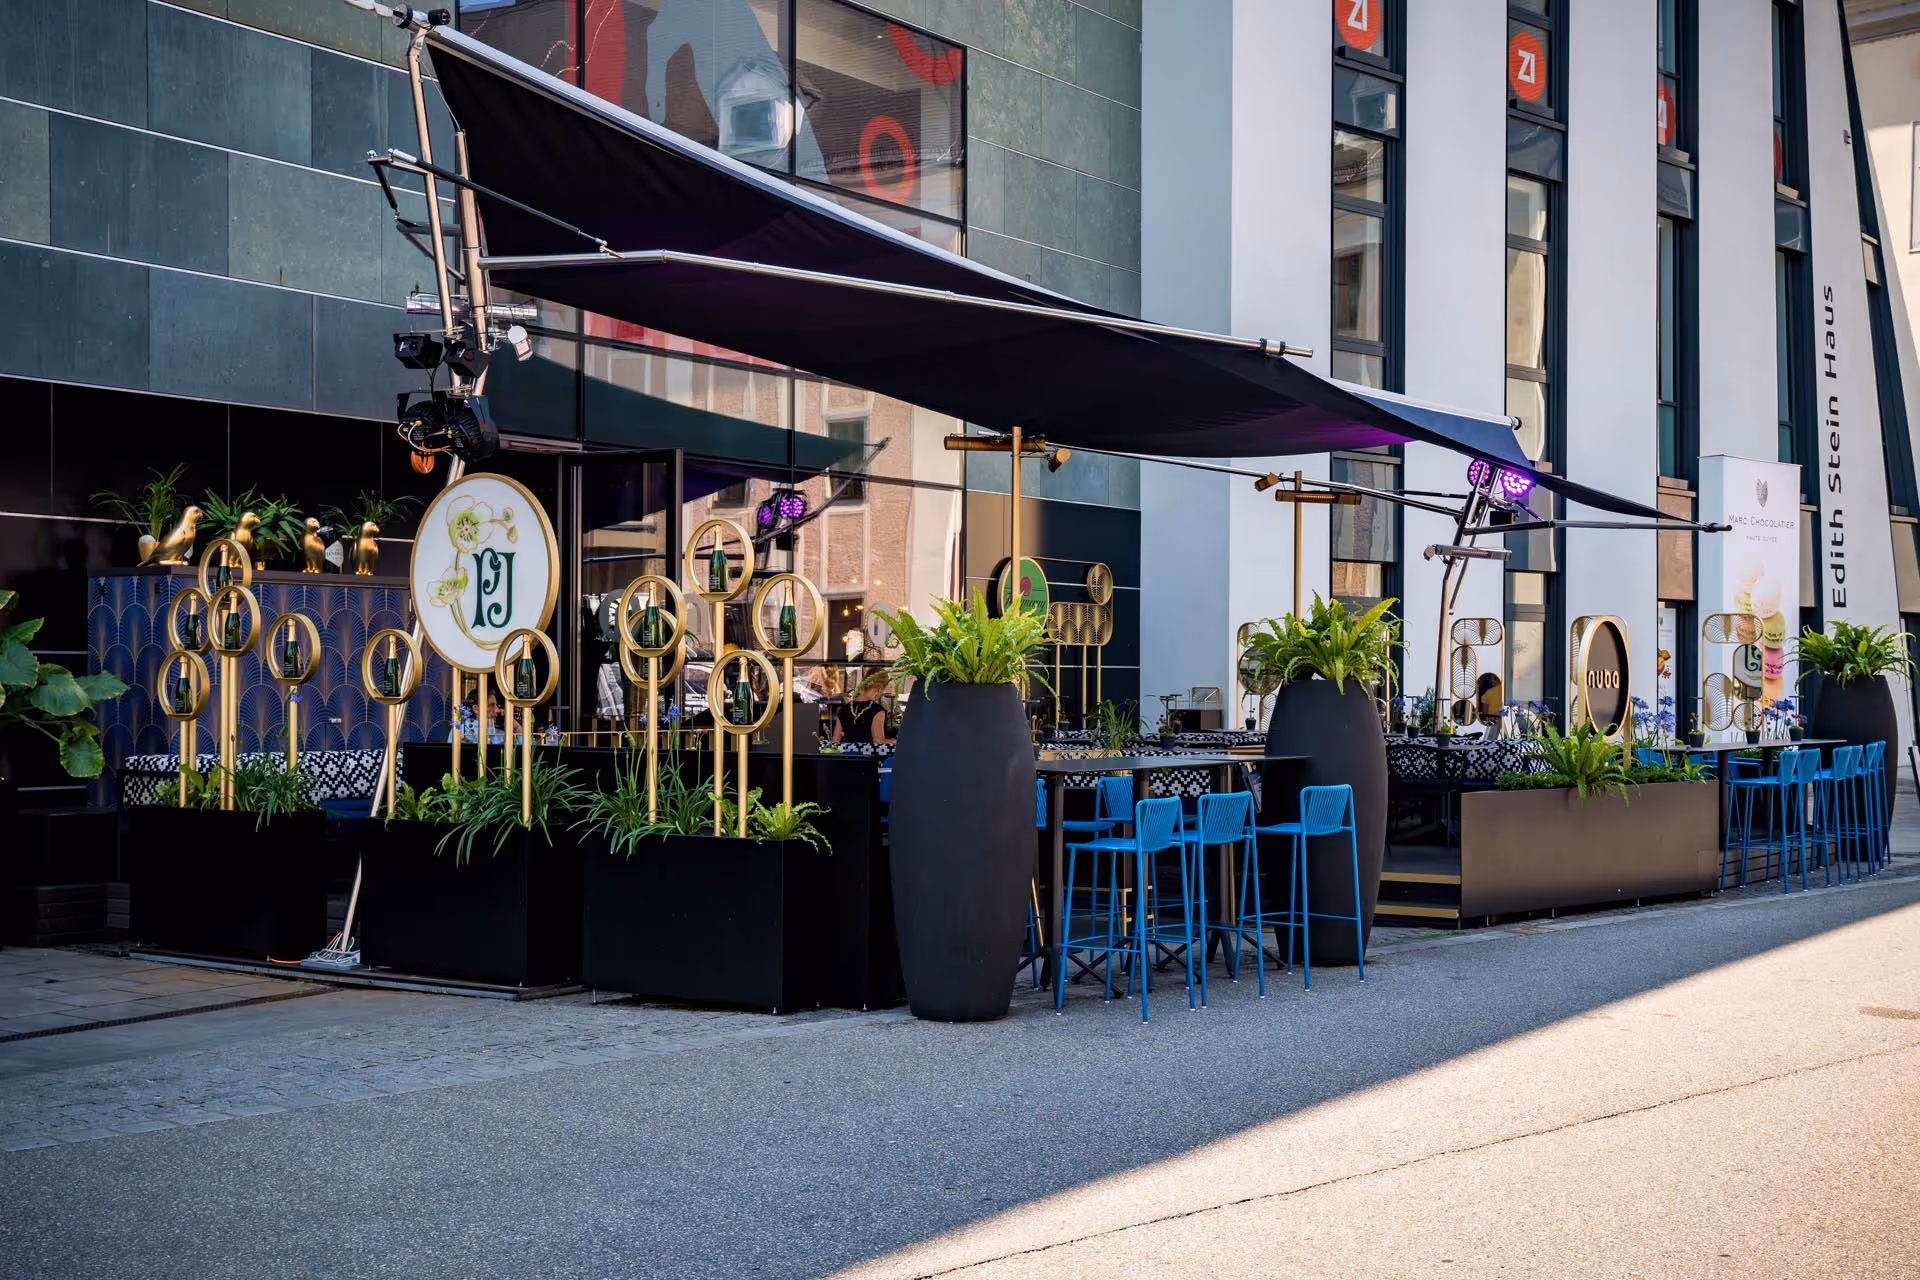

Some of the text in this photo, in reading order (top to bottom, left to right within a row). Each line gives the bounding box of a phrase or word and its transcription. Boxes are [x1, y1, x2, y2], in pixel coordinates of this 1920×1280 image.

[1823, 285, 1848, 608] Edith Stein Haus
[1587, 668, 1620, 689] nuba
